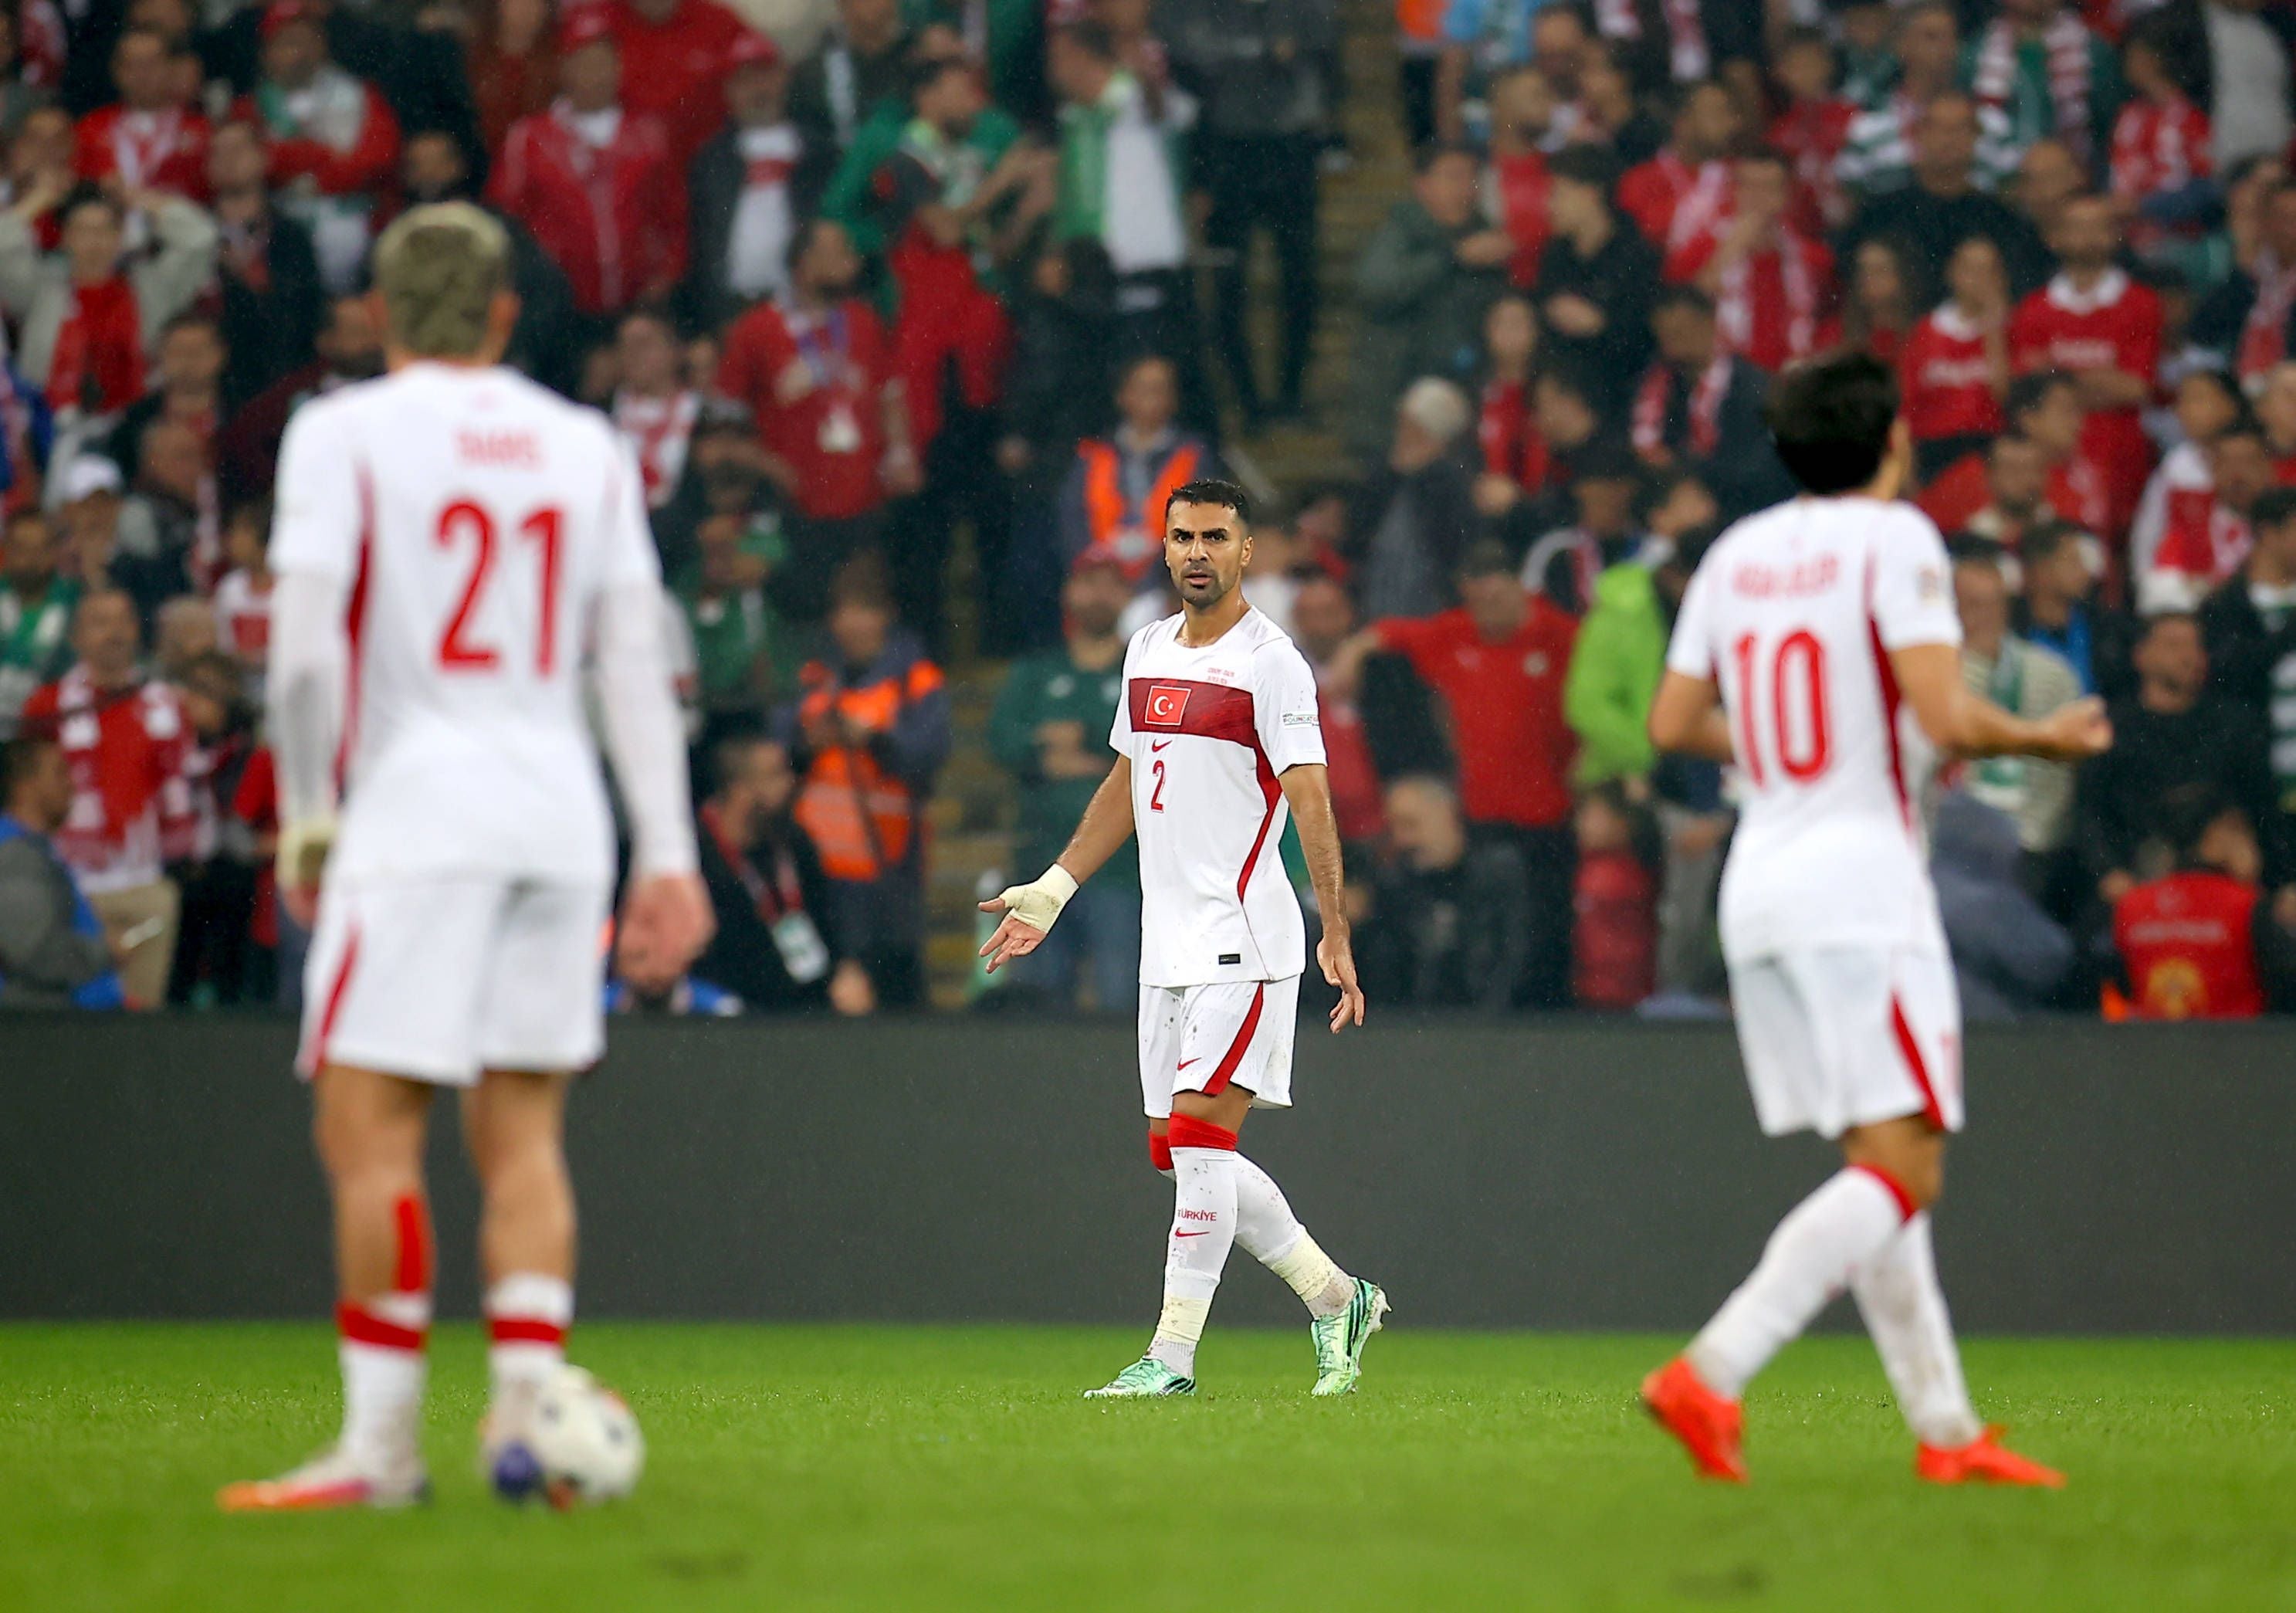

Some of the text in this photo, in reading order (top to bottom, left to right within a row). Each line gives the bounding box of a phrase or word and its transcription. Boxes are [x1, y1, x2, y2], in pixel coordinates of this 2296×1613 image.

[434, 496, 567, 681] 21
[1150, 760, 1166, 813] 2
[1734, 626, 1832, 790] 10
